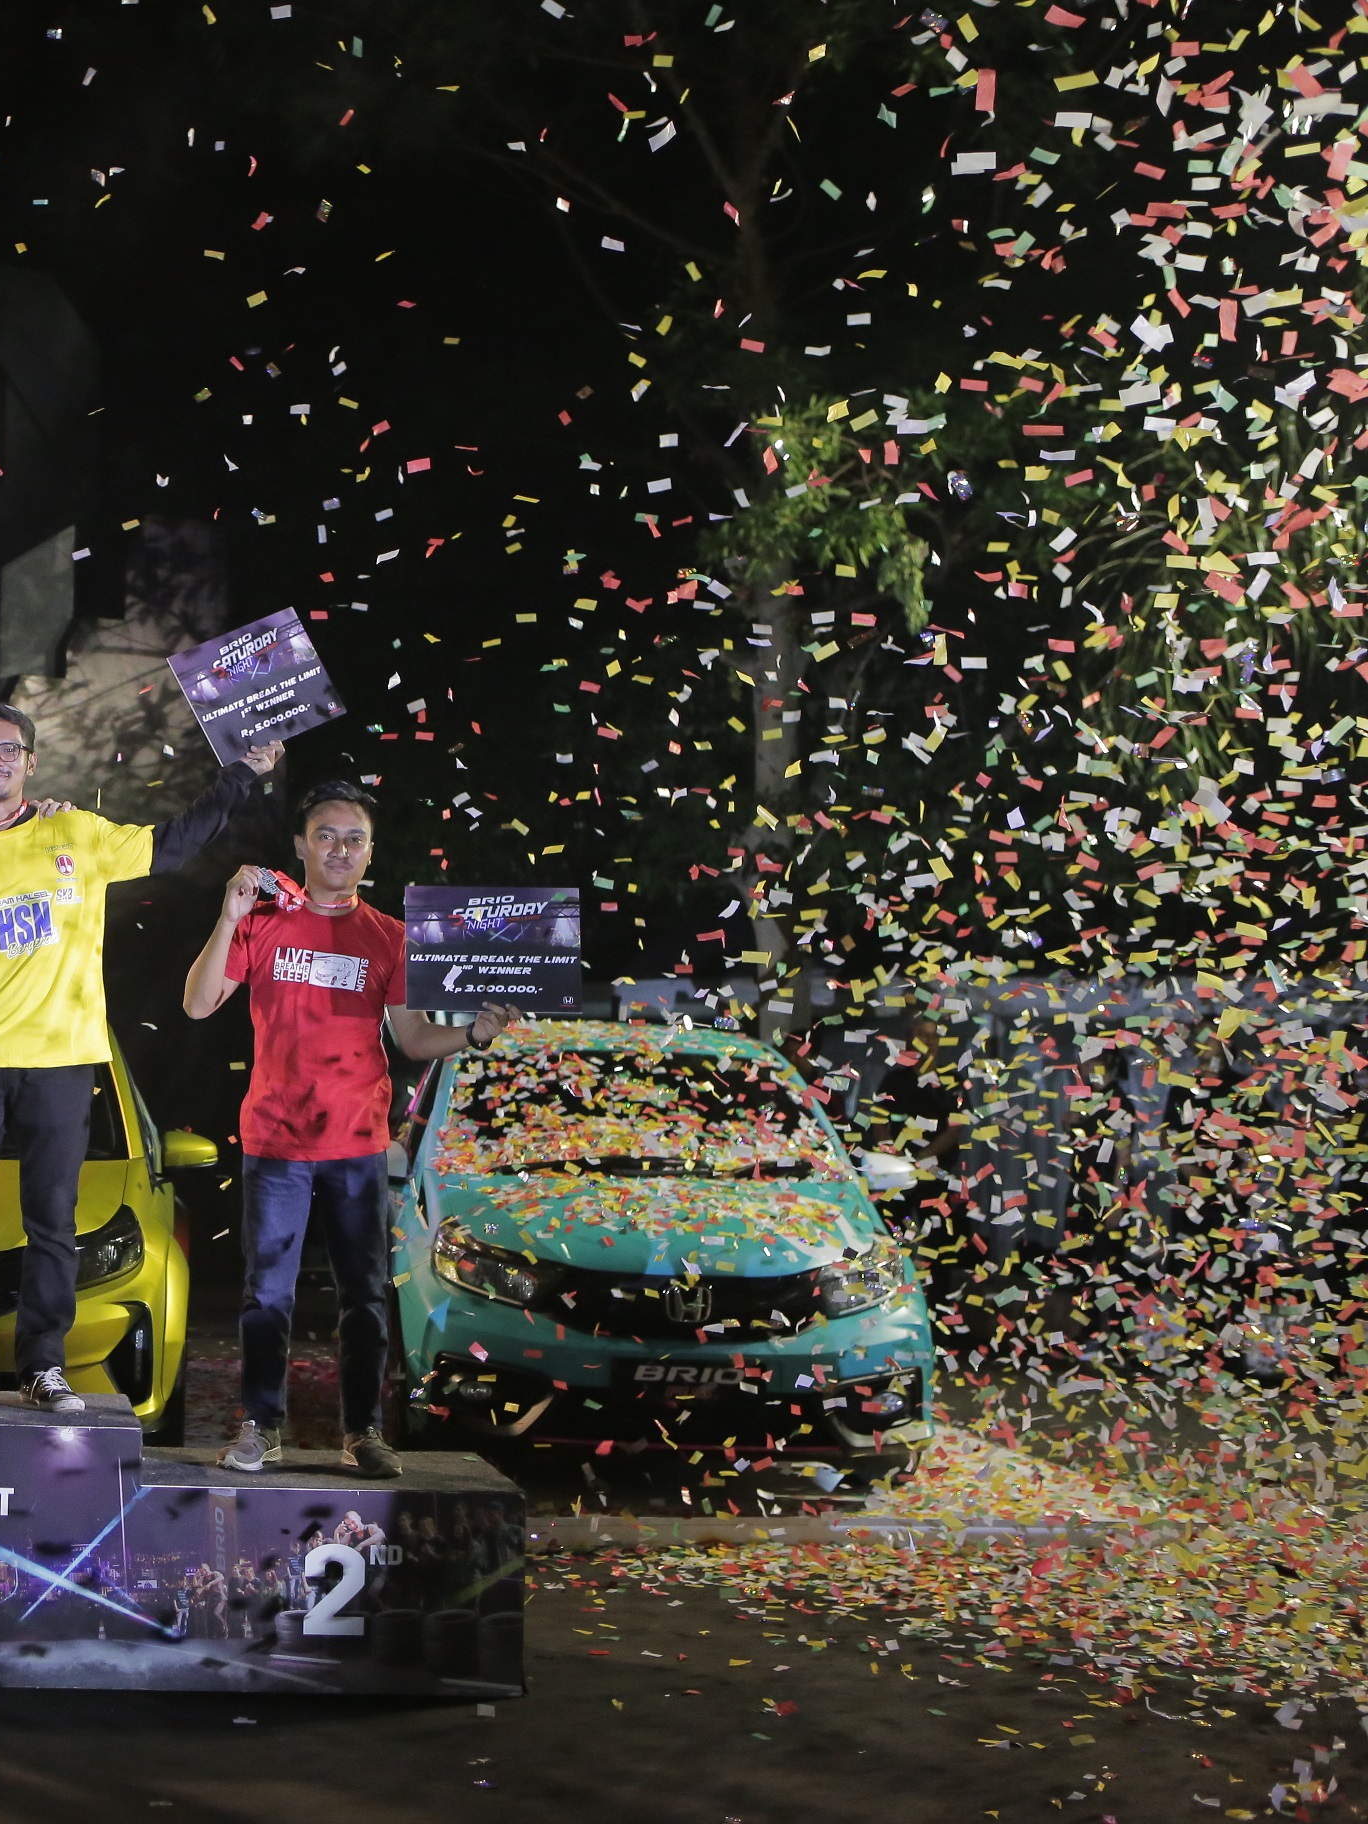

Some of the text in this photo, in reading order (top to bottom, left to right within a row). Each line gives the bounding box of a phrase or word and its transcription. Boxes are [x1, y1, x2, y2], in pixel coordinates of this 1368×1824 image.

[211, 628, 278, 678] SATURDAY
[219, 633, 252, 656] BRIO
[227, 655, 254, 676] NIGHT
[202, 666, 321, 722] ULTIMATE BREAK THE LIMIT
[256, 690, 295, 712] WINNER
[15, 891, 50, 903] HALSEL
[468, 895, 514, 906] BRIO
[448, 901, 548, 926] SATURDAY
[466, 917, 505, 931] NIGHT
[275, 947, 312, 962] LIVE
[410, 954, 468, 962] ULTIMATE
[470, 955, 514, 963] BREAK
[544, 956, 577, 964] LIMIT
[272, 969, 309, 983] SLEEP
[274, 962, 309, 973] BREATHE
[355, 958, 369, 992] SLALOM
[478, 966, 531, 975] WINNER
[633, 1364, 744, 1385] BRIO
[215, 1506, 226, 1572] BRIO
